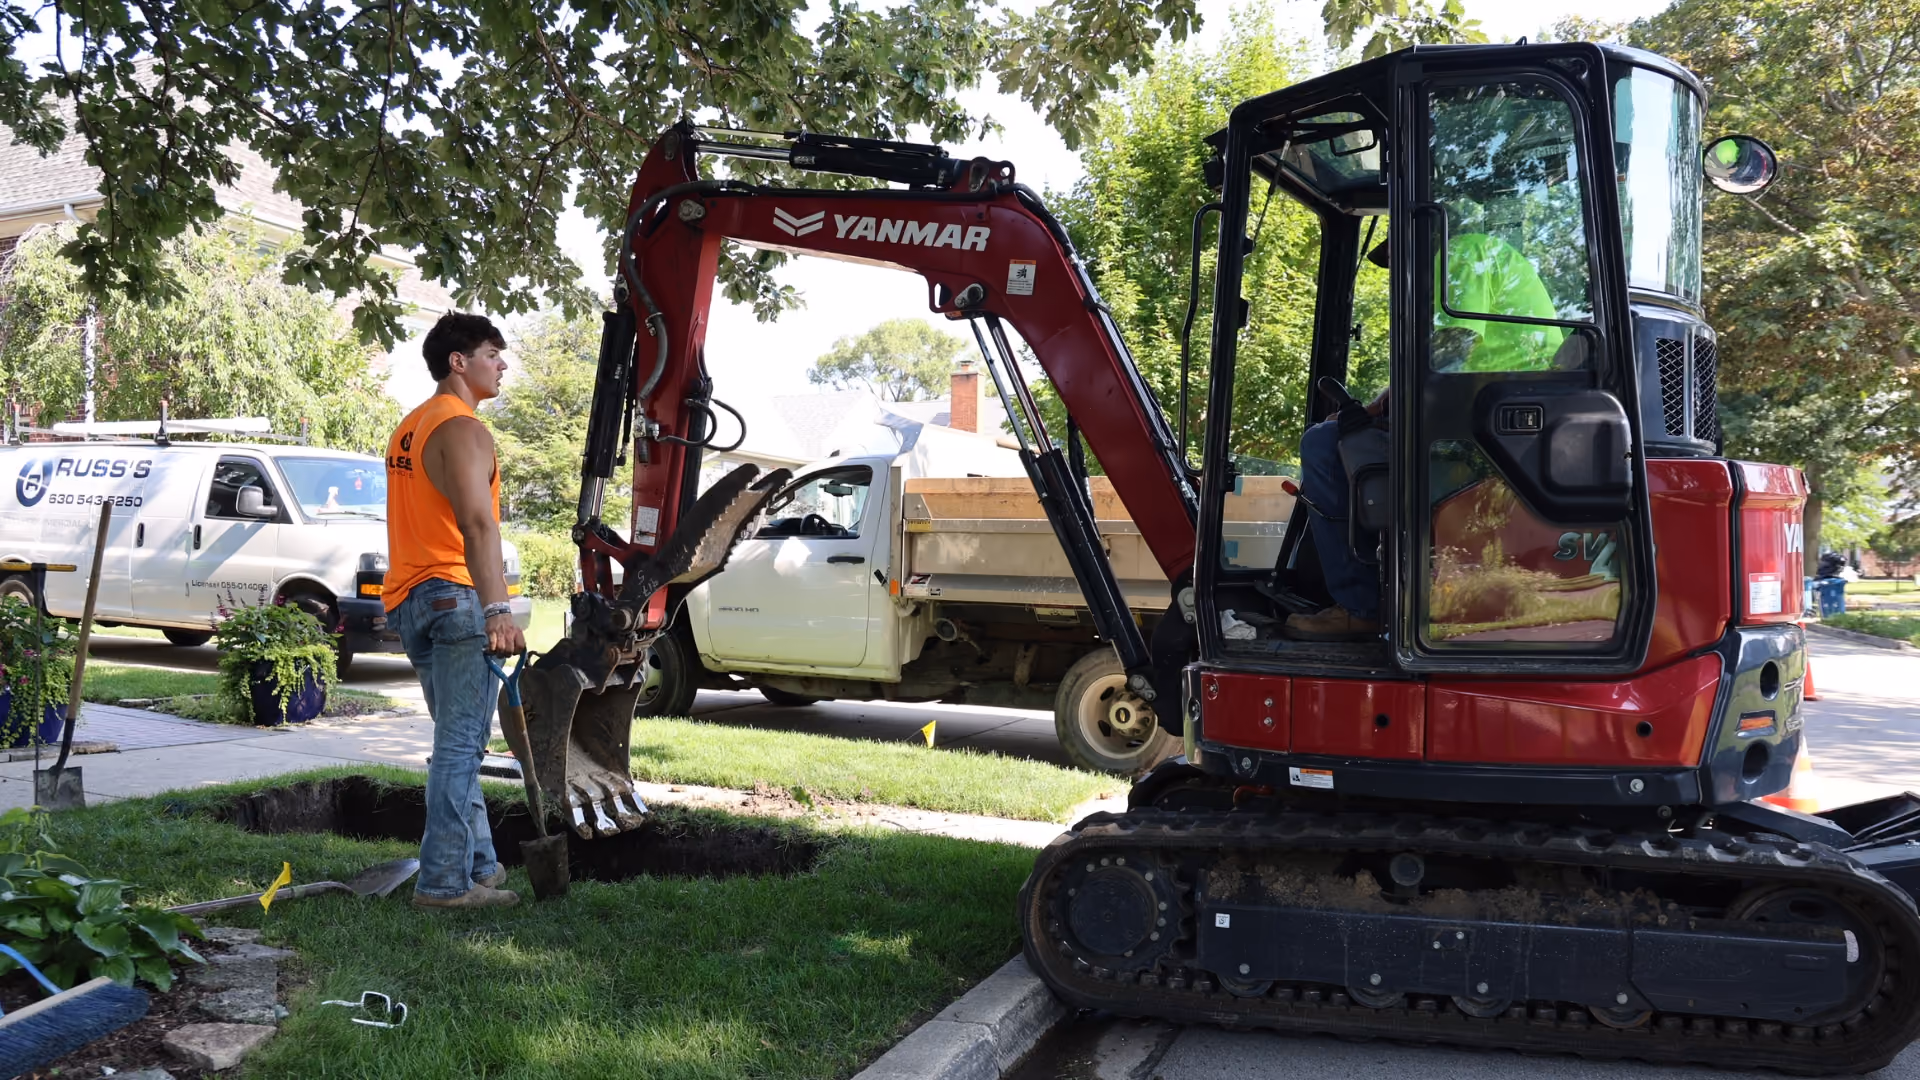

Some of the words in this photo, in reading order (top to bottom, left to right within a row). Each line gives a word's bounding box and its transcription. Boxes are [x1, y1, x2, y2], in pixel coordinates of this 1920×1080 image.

[833, 213, 991, 251] YANMAR
[56, 458, 152, 478] RUSS'S
[49, 493, 74, 504] 630
